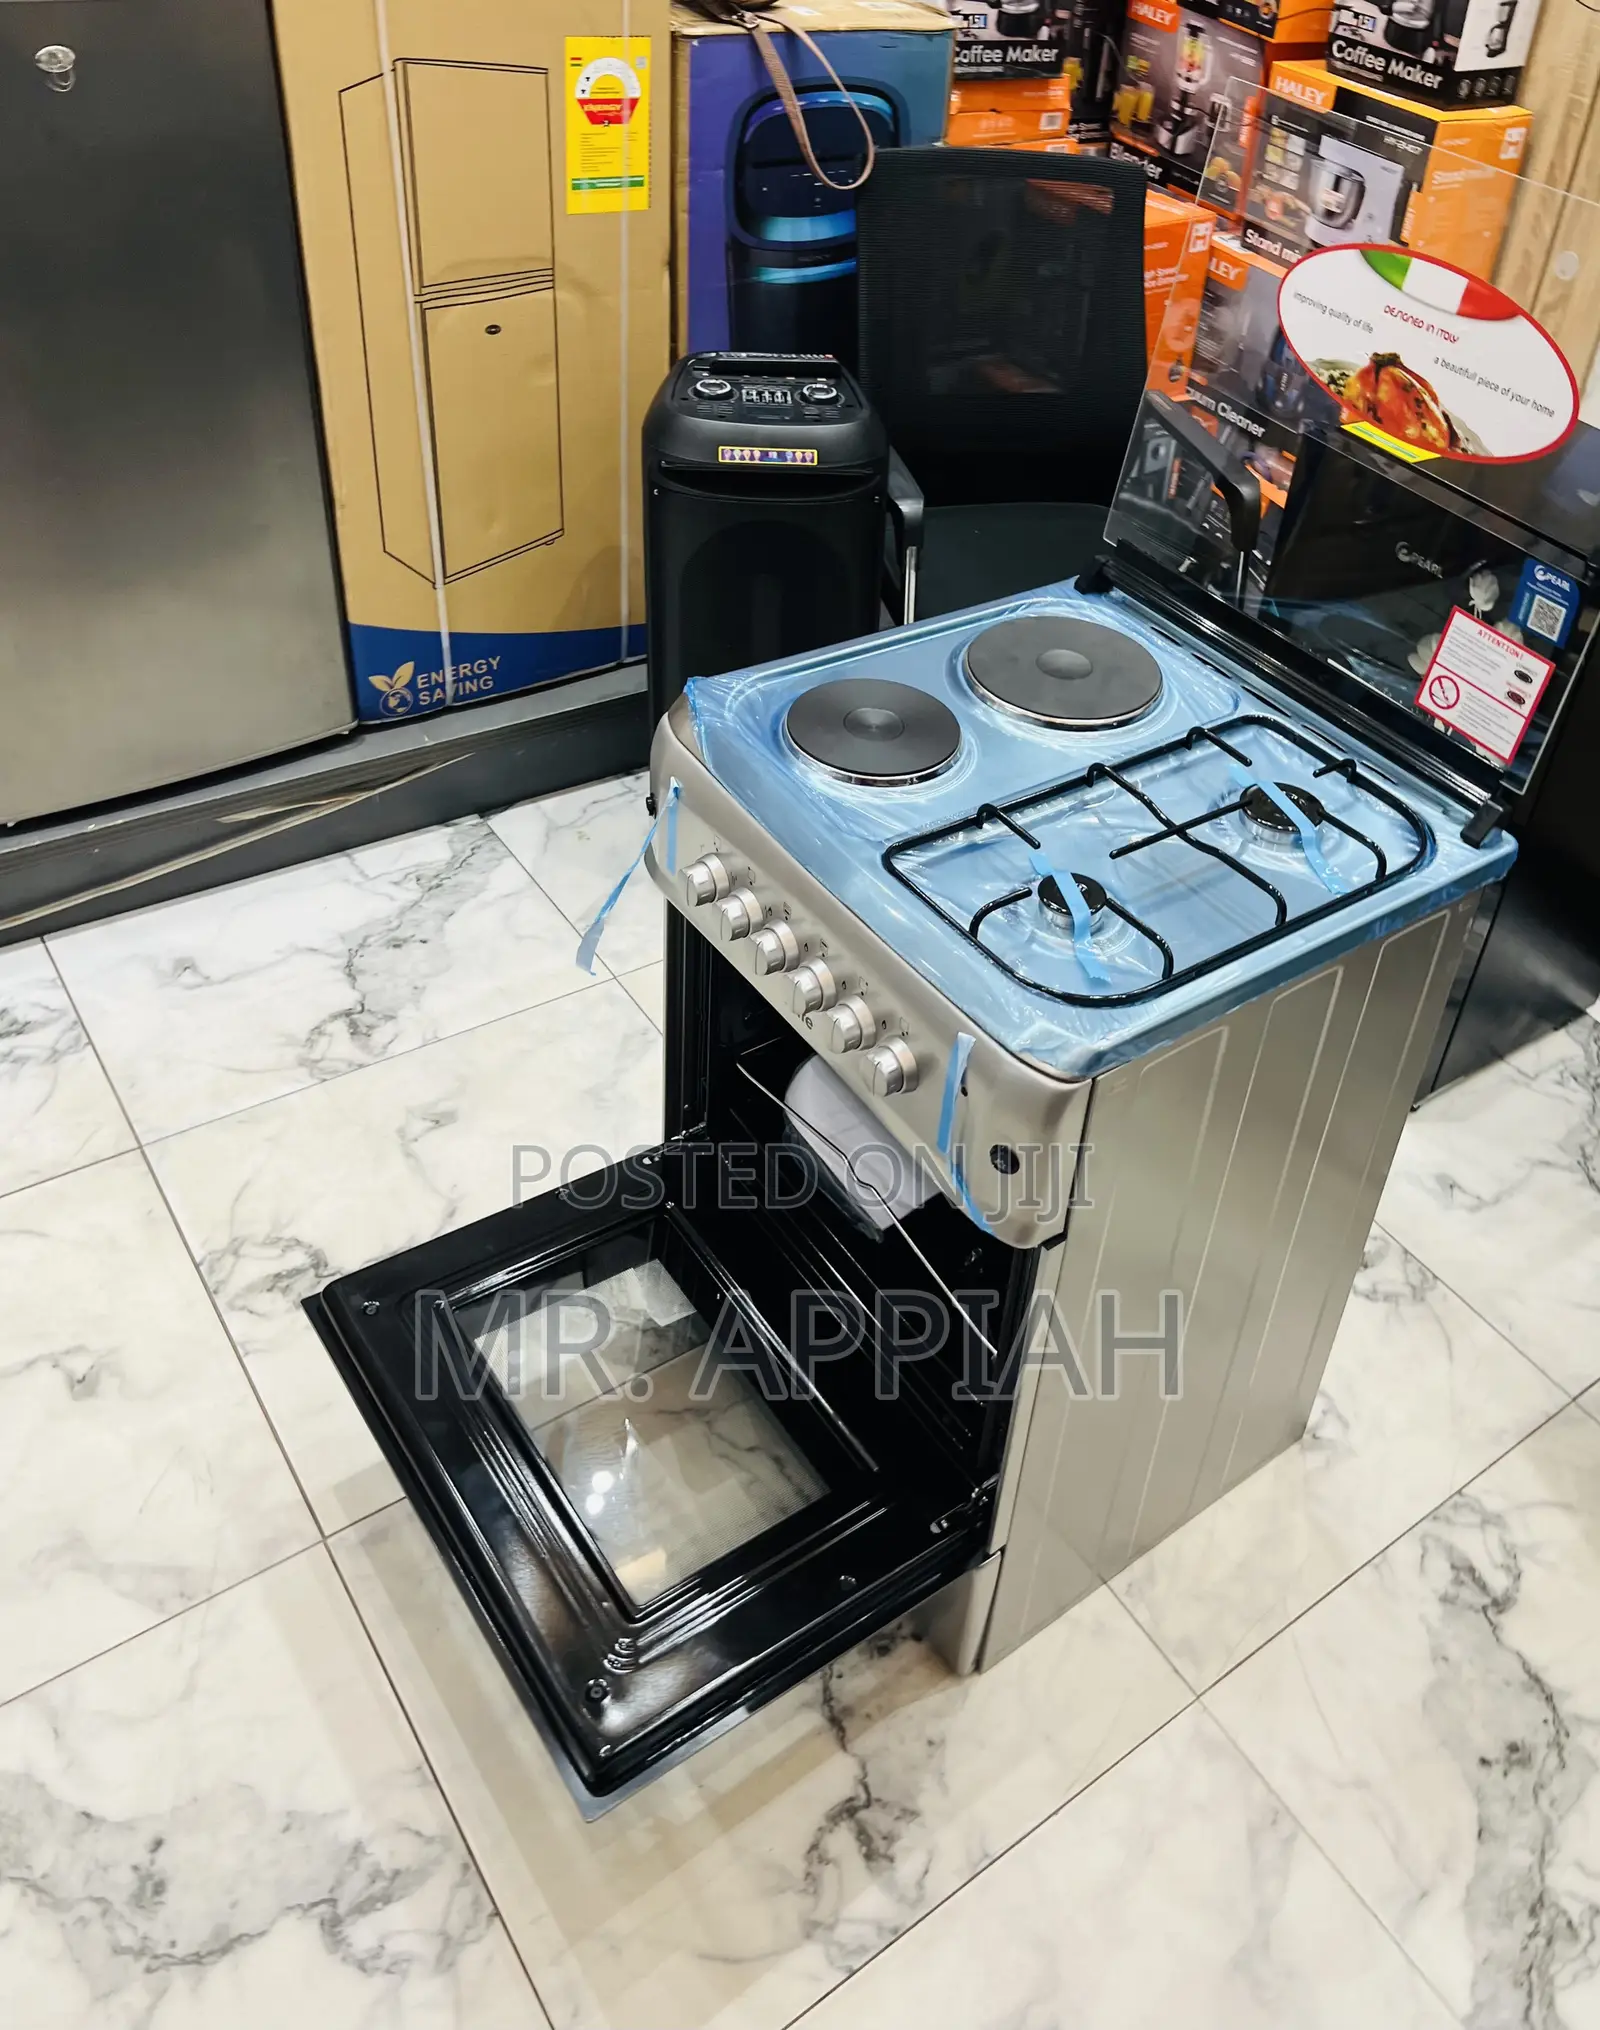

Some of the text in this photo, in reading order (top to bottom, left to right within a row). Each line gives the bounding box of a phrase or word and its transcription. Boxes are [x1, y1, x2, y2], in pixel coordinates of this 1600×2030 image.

[1006, 44, 1059, 63] Maker
[1332, 40, 1386, 71] Coffee
[1387, 58, 1444, 89] Maker
[1275, 76, 1331, 105] HALEY
[1244, 229, 1282, 256] Stand
[1209, 257, 1242, 281] LEY
[1293, 292, 1374, 334] improving quality of life
[1383, 304, 1425, 328] DESIGNED
[1436, 327, 1460, 345] ITALY
[1433, 356, 1440, 365] a
[1477, 376, 1500, 393] piece
[1500, 387, 1511, 397] of
[1509, 391, 1530, 407] your
[1531, 398, 1555, 418] home
[1217, 401, 1266, 438] Cleaner
[1476, 629, 1524, 661] ATTENTION!
[417, 655, 502, 689] ENERGY
[419, 675, 494, 706] SAING
